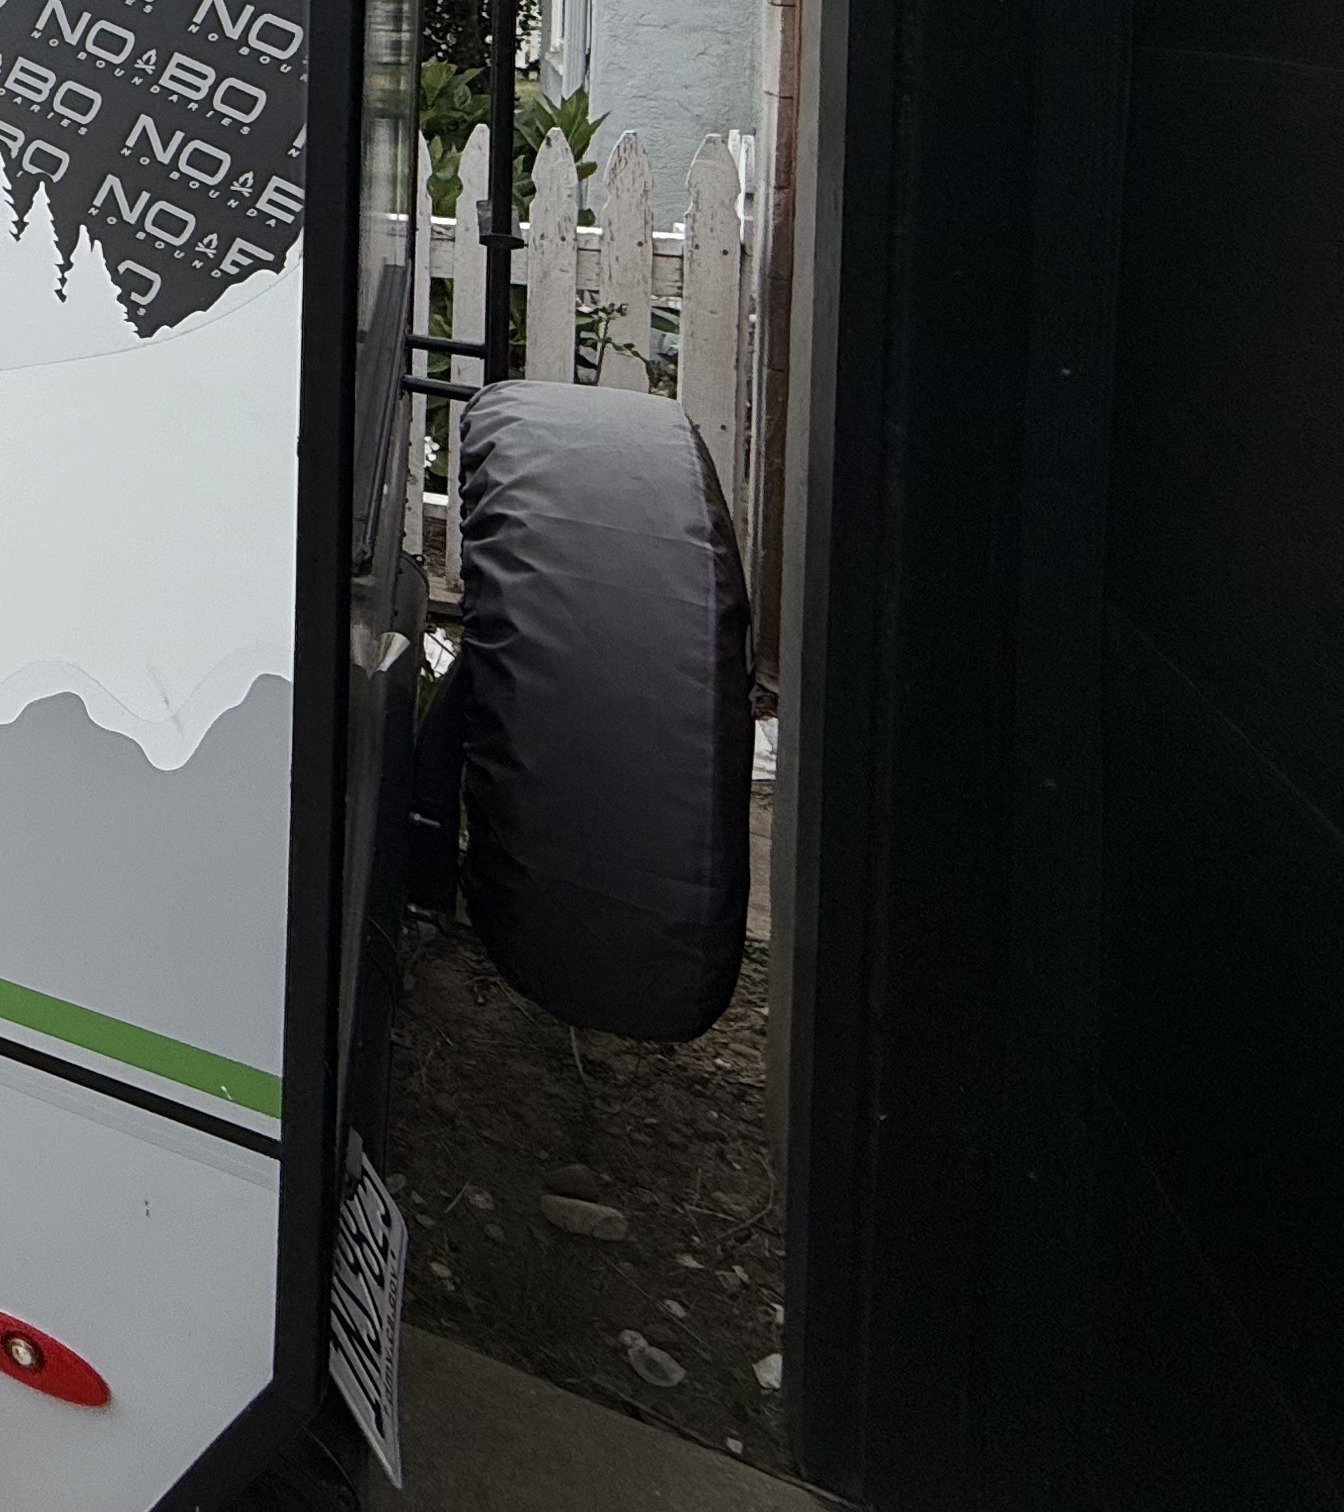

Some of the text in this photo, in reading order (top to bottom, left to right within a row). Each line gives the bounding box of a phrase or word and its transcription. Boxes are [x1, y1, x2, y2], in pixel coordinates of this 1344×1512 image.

[4, 56, 102, 125] BO
[158, 52, 267, 124] BO
[125, 113, 231, 186] NO
[92, 174, 196, 247] NO
